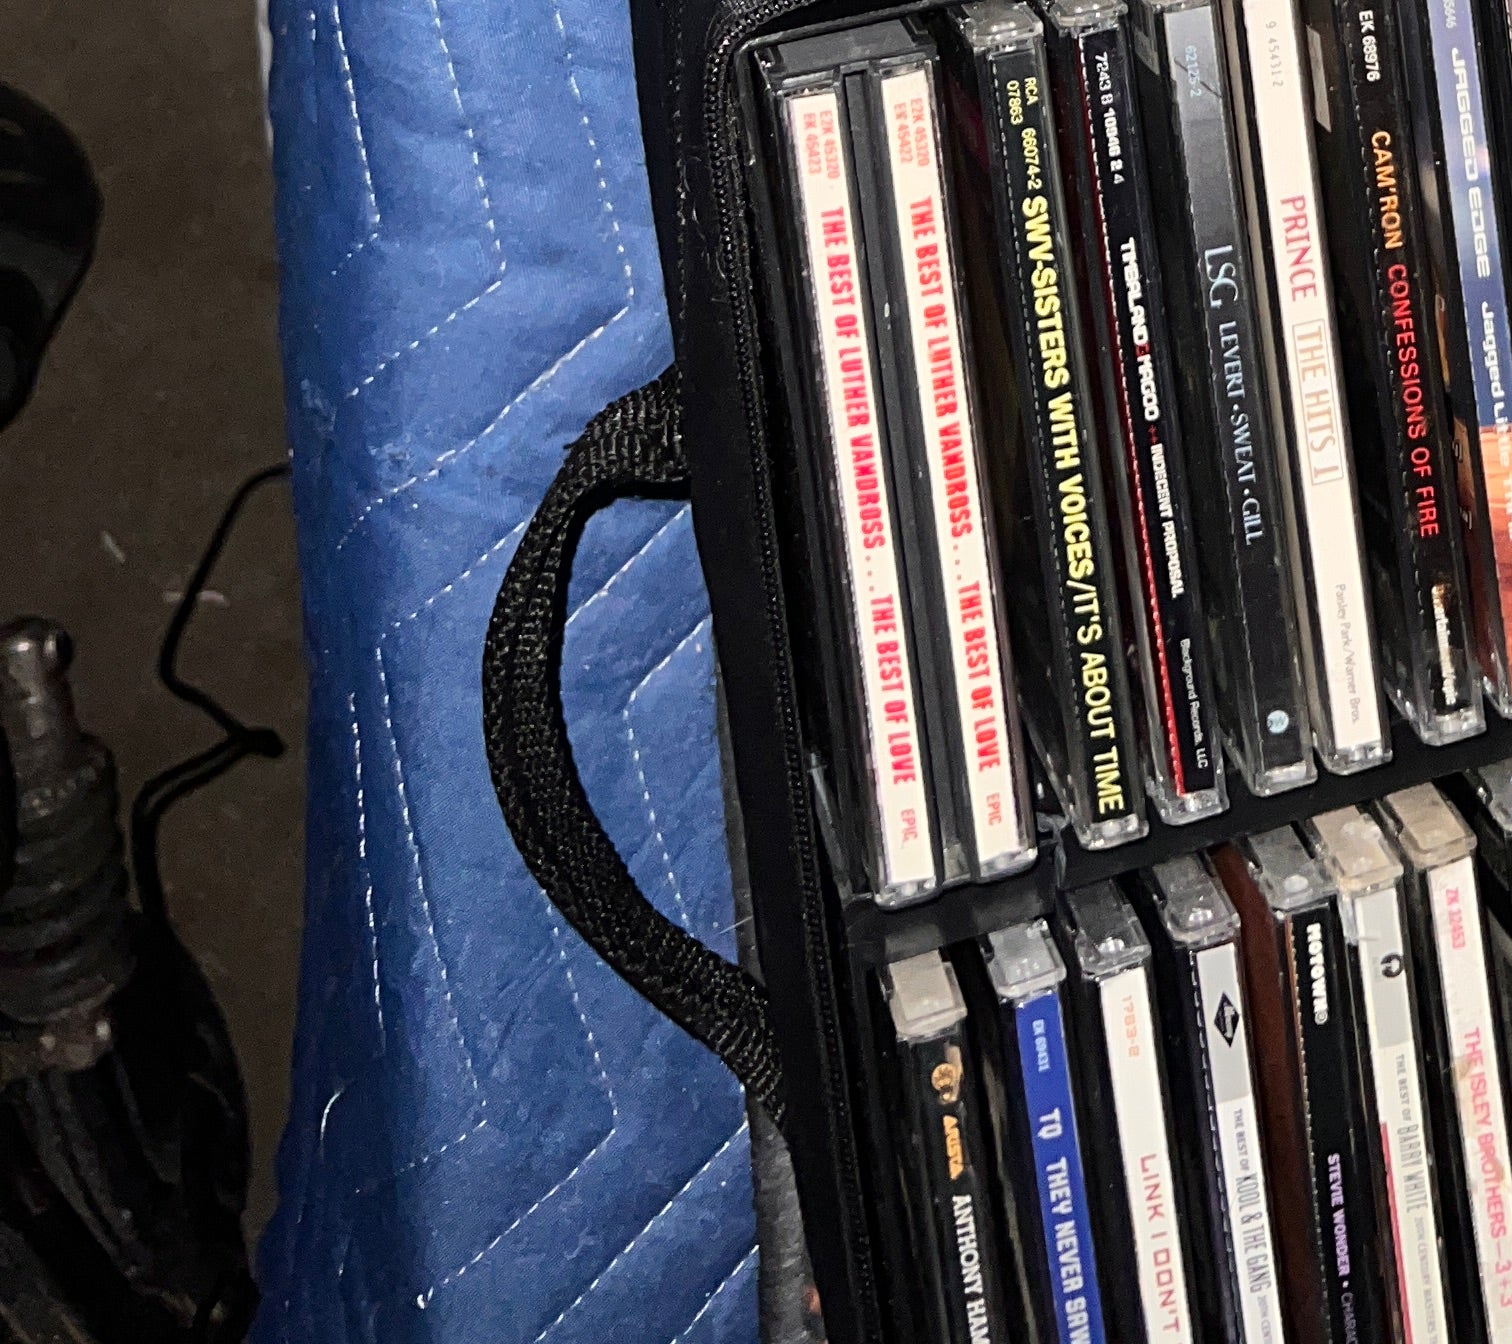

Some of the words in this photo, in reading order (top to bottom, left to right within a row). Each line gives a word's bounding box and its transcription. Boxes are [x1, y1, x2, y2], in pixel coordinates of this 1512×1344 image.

[910, 196, 937, 238] THE
[1371, 130, 1404, 249] CAM'RON
[915, 242, 945, 296] BEST
[1204, 244, 1239, 307] LSG
[1280, 194, 1318, 301] PRINCE
[924, 303, 949, 328] OF
[1022, 194, 1071, 389] SWV-SISTERS
[928, 335, 959, 417] LUTHER
[1219, 320, 1244, 401] LEVERT
[1293, 325, 1327, 378] THE
[1388, 263, 1428, 439] CONFESSIONS
[1048, 391, 1081, 469] WITH
[1230, 412, 1254, 482] SWEAT
[1299, 389, 1336, 453] HITS
[1411, 446, 1433, 477] OF
[1239, 497, 1265, 546] GILL
[1416, 485, 1440, 537] FIRE
[1058, 472, 1104, 645] VOICES/IT'S
[958, 580, 985, 623] THE
[963, 625, 991, 679] BEST
[970, 684, 995, 710] OF
[1080, 651, 1116, 738] ABOUT
[974, 715, 1002, 772] LOVE
[1093, 745, 1125, 814] TIME
[1463, 1029, 1483, 1068] THE
[1037, 1107, 1064, 1139] TQ
[1468, 1071, 1492, 1127] ISLEY
[1046, 1156, 1074, 1214] THEY
[952, 1193, 984, 1294] ANTHONY
[1054, 1219, 1085, 1293] NEVER
